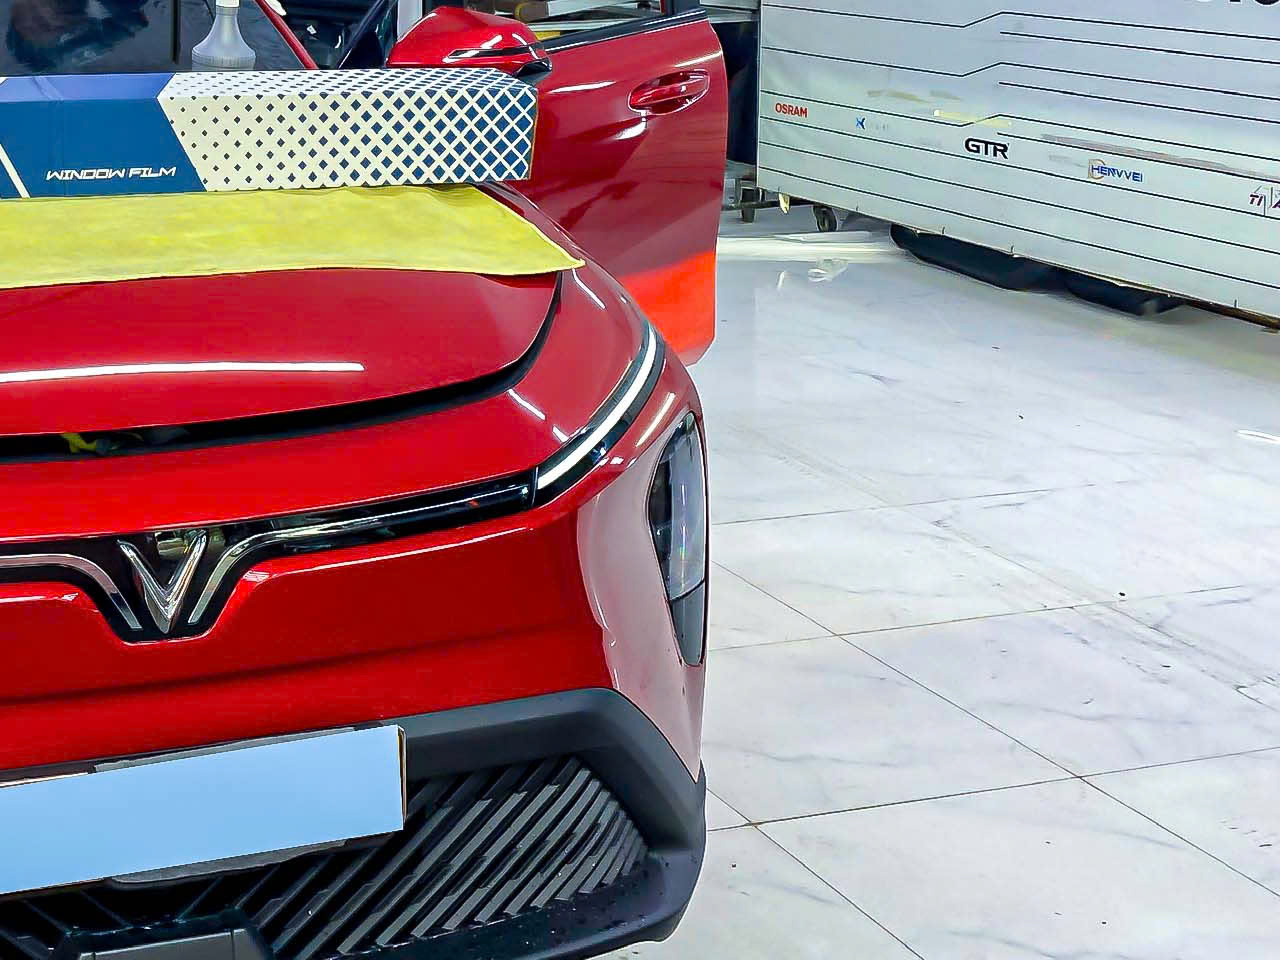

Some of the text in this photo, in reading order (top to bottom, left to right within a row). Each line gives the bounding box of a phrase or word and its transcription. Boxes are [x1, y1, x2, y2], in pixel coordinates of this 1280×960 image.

[775, 102, 808, 118] OSRAM
[964, 137, 1010, 160] GTR
[45, 166, 177, 181] WINDOW FILM
